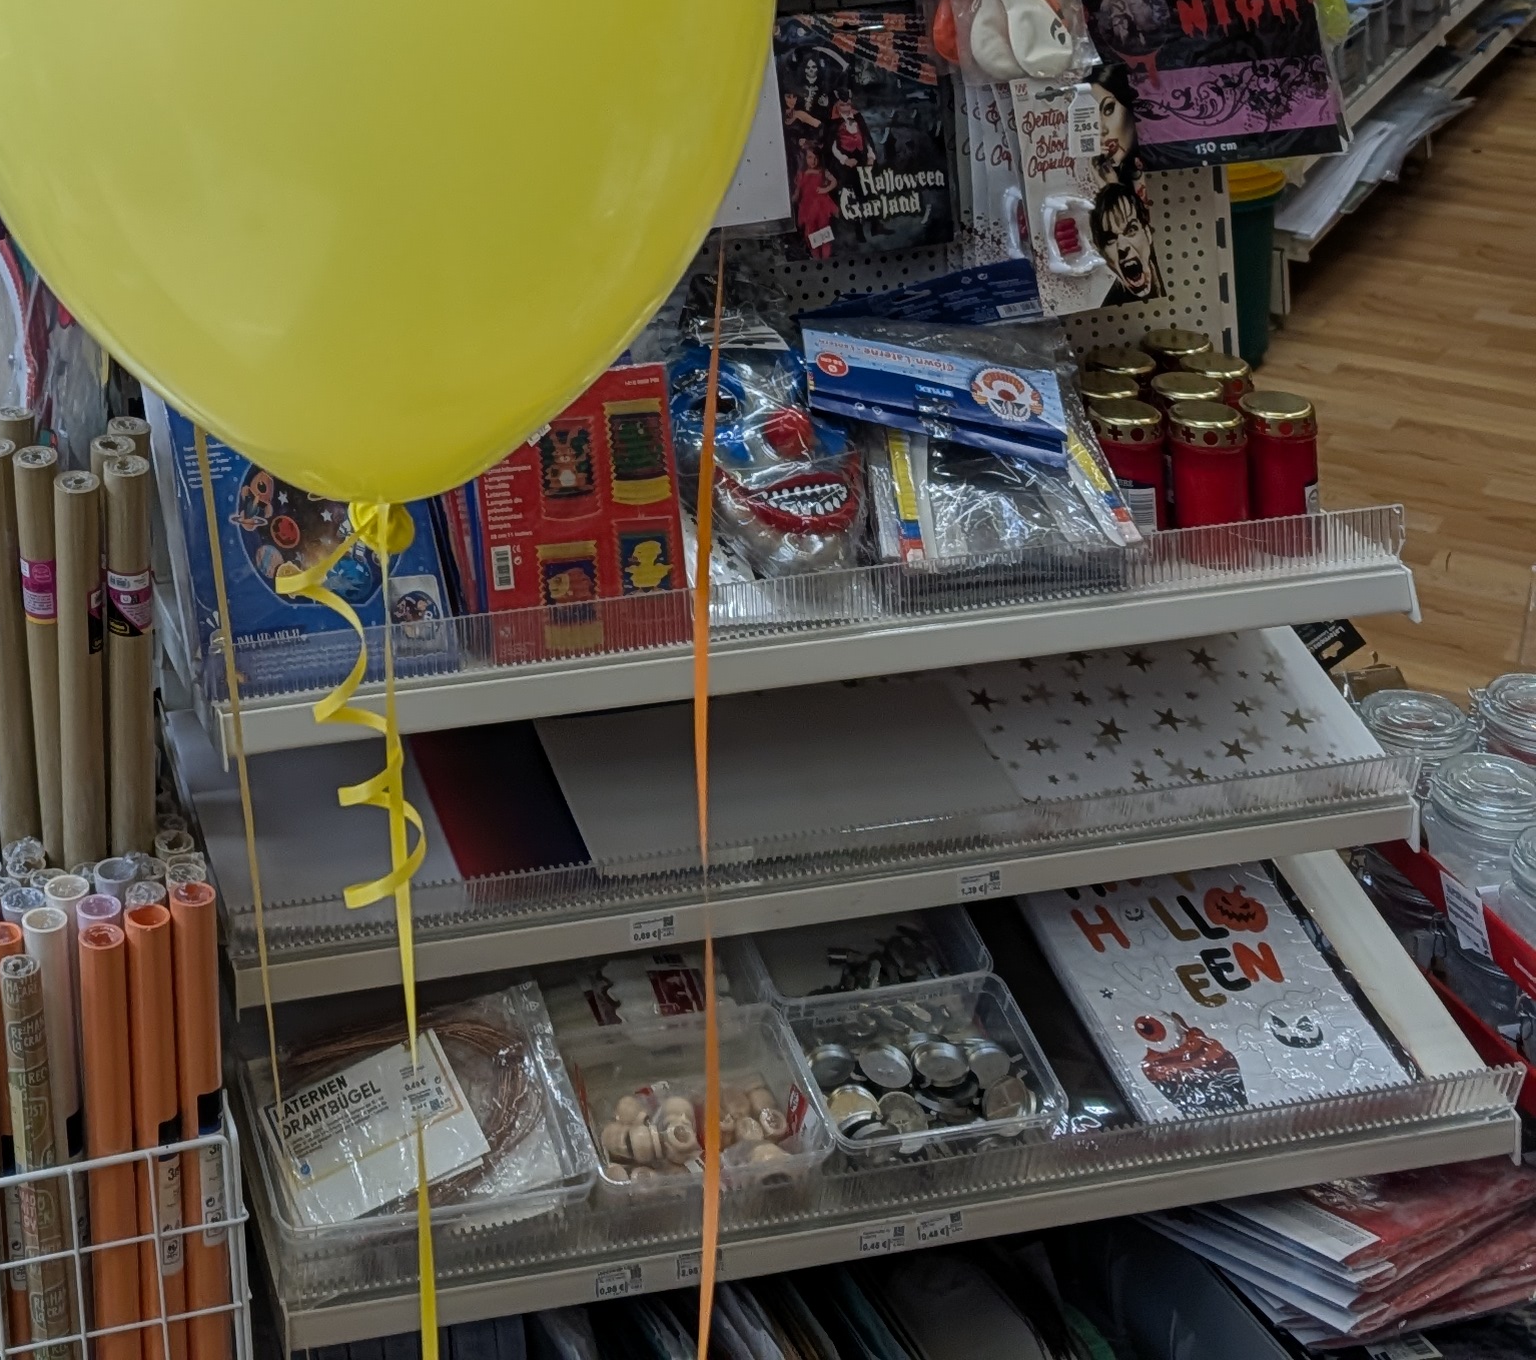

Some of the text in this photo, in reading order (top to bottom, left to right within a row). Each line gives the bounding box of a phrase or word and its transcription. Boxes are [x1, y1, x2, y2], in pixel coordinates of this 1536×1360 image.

[1074, 123, 1092, 132] 2,95
[1220, 142, 1238, 151] cm
[856, 166, 945, 196] Halloween
[839, 186, 922, 222] Garland
[273, 1074, 348, 1123] LATERNEN
[281, 1080, 382, 1140] DRAHTBÜGEL
